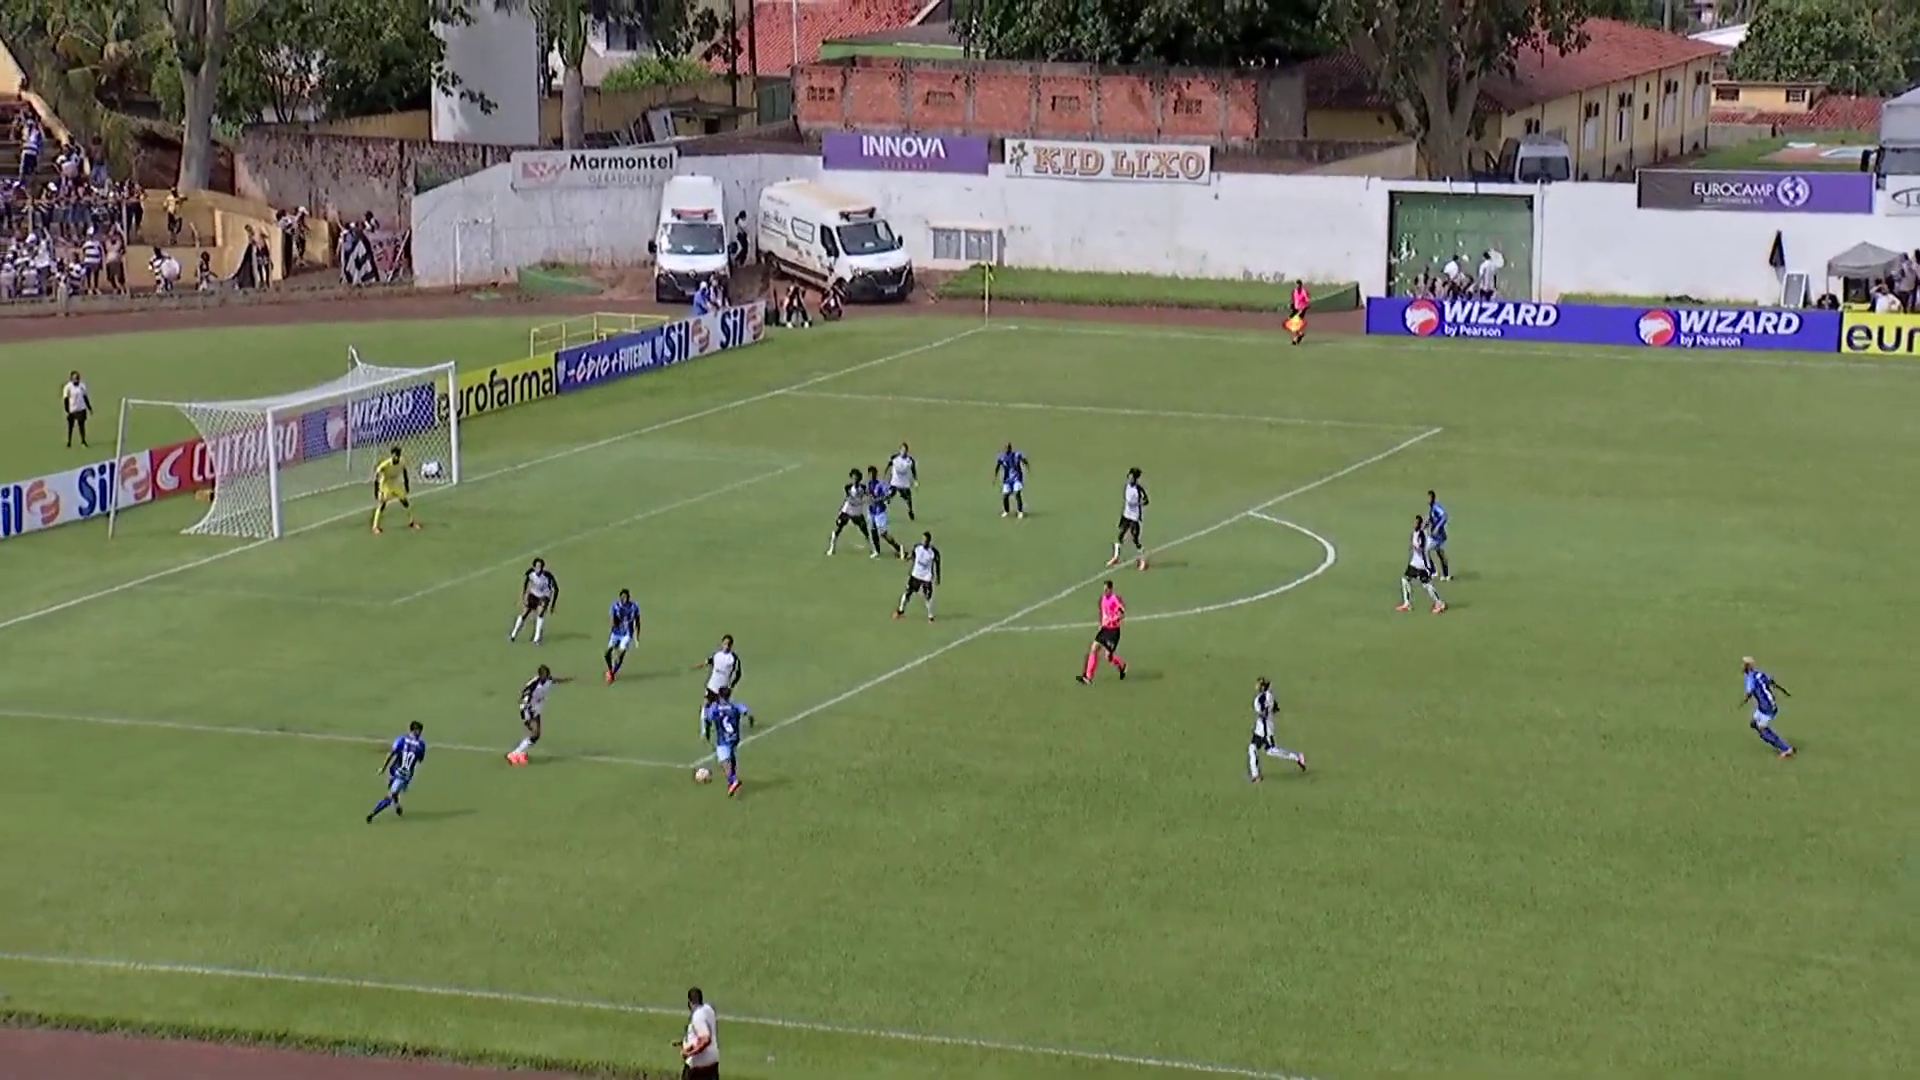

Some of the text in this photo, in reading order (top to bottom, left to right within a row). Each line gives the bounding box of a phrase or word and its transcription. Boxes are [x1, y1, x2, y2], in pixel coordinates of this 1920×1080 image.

[862, 135, 946, 158] INNOVA
[569, 153, 674, 170] Marmontel
[1033, 145, 1206, 180] KID LIXO
[1693, 182, 1775, 196] EUROCAMP
[1443, 300, 1558, 326] WIZARD
[1678, 309, 1801, 335] WIZARD
[720, 307, 745, 349] Sil
[1444, 324, 1501, 337] by Pearson
[1680, 335, 1741, 347] by Pearson
[664, 320, 690, 366] Sil
[78, 462, 116, 517] Sil
